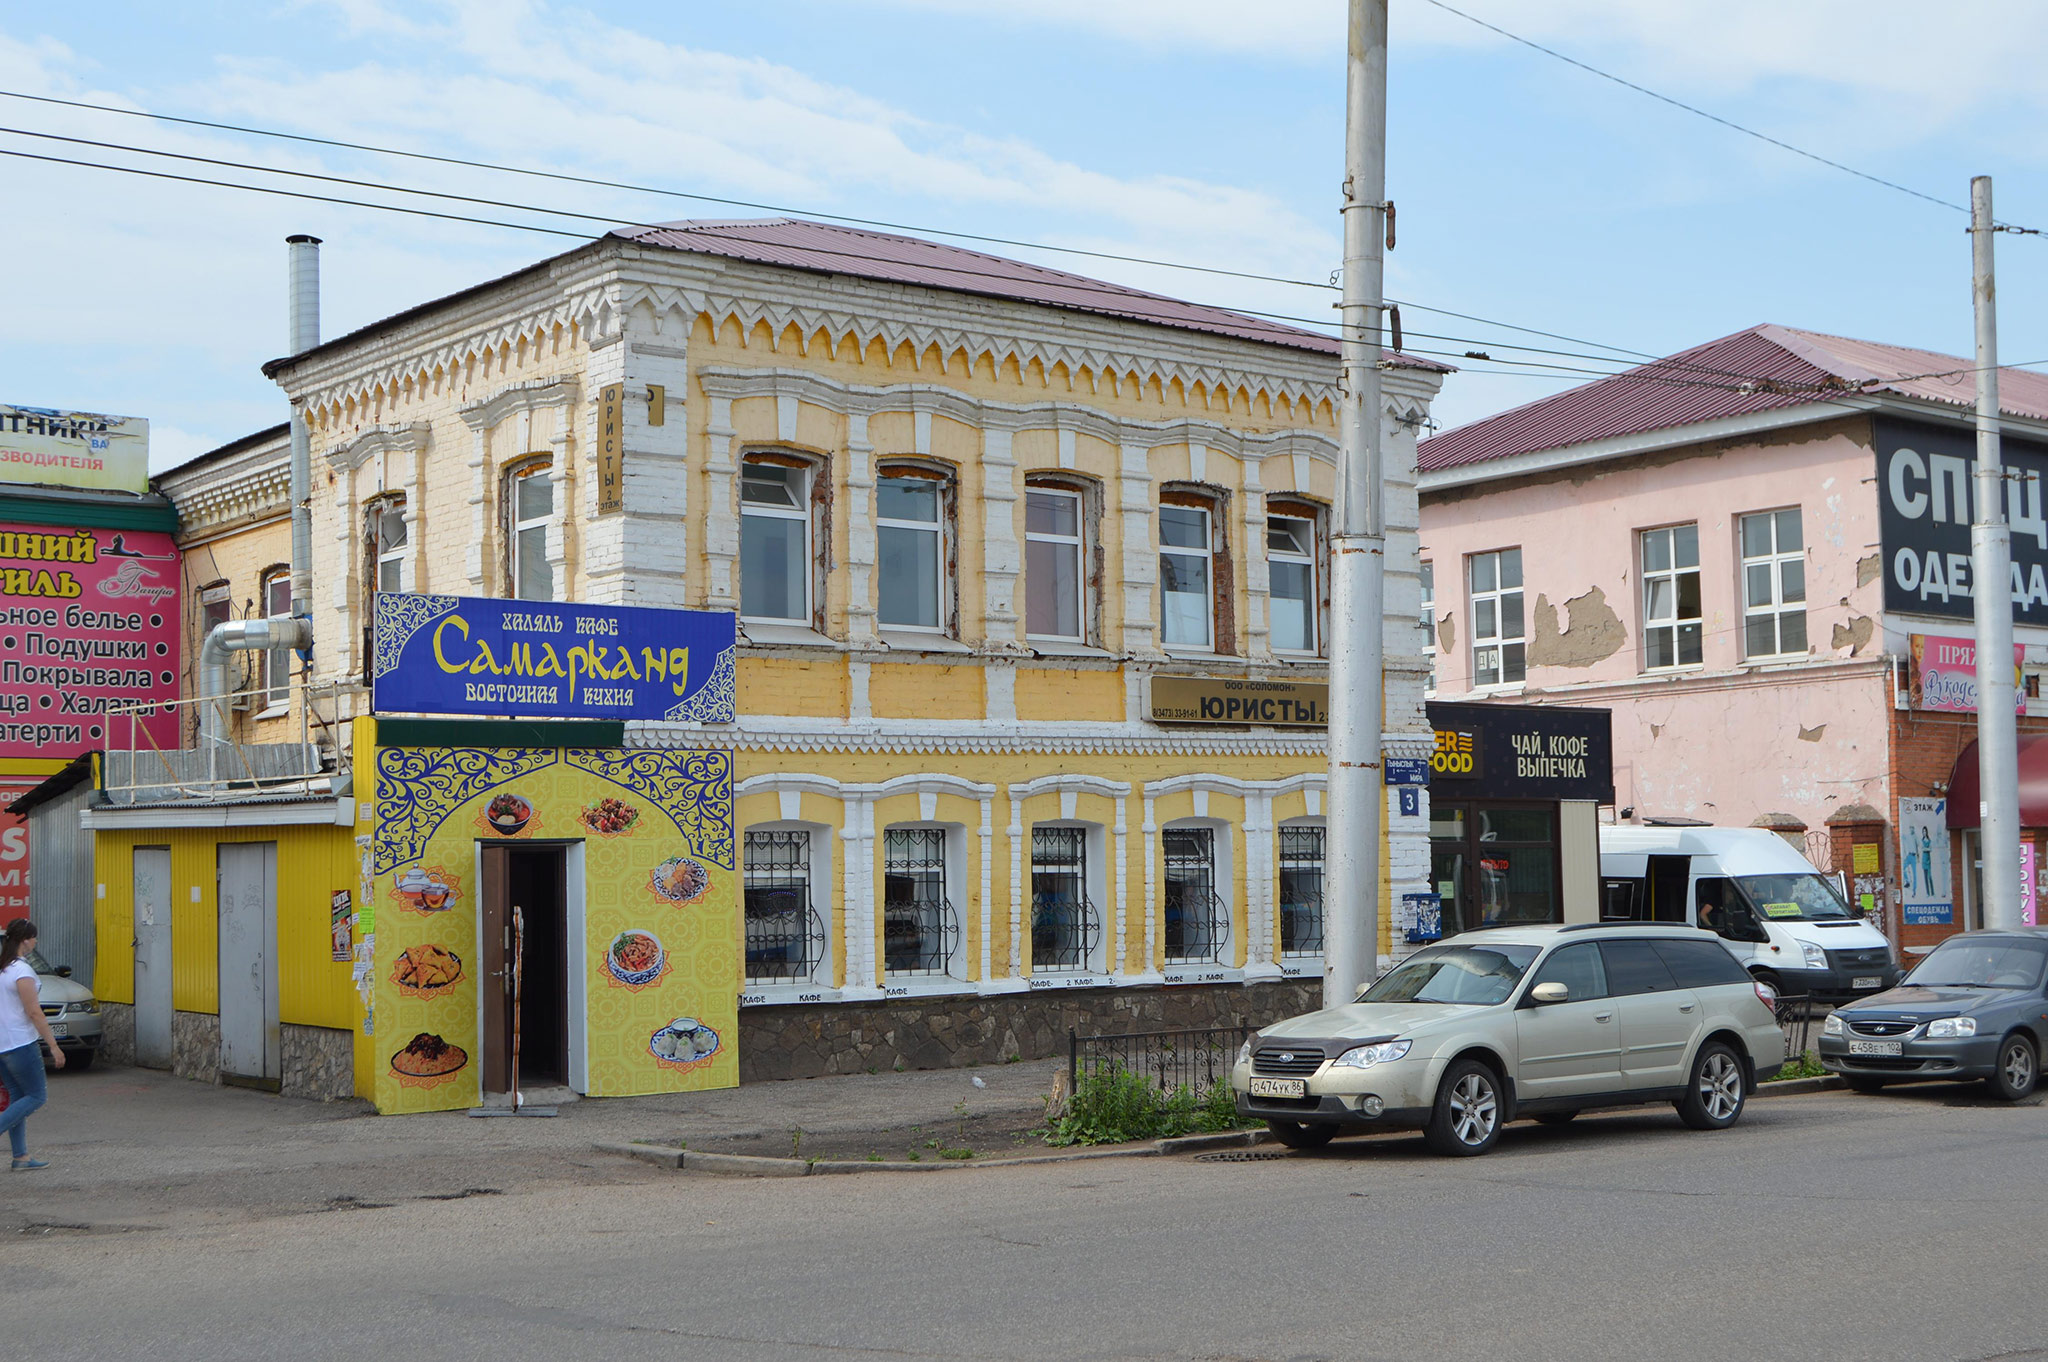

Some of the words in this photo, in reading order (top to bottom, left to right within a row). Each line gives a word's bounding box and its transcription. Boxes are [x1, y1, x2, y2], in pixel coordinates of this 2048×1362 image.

[604, 389, 616, 487] ЮРИСТЫ
[600, 499, 620, 511] этаж
[606, 490, 612, 500] 2
[1888, 448, 2047, 550] СПЦ
[1894, 547, 2048, 612] ОДЕДА
[65, 604, 142, 631] белье
[502, 612, 563, 633] ХАЛЯЛЬ
[575, 616, 619, 636] КАФЕ
[26, 632, 147, 662] Подушки
[432, 614, 690, 703] Самарканд
[2, 660, 153, 690] Покрывала
[465, 682, 558, 704] ВОСТОЧНАЯ
[583, 685, 634, 707] КУХНЯ
[1224, 681, 1243, 691] ООО
[60, 690, 156, 716] Халаты
[1200, 696, 1316, 722] ЮРИСТЫ
[1319, 711, 1325, 722] 2
[0, 722, 81, 747] терти
[1511, 731, 1545, 758] ЧАЙ,
[1550, 736, 1589, 756] КОФЕ
[1517, 757, 1587, 778] ВЫПЕЧКА
[1406, 794, 1415, 811] 3
[1914, 803, 1934, 812] ЭТАЖ
[1906, 905, 1950, 915] СПЕЦОДЕЖДА
[1074, 978, 1094, 986] КАФЕ
[1164, 975, 1184, 983] КАФЕ
[1206, 973, 1224, 981] КАФЕ
[1283, 968, 1301, 976] КАФЕ
[743, 995, 766, 1004] КАФЕ
[799, 993, 822, 1002] КАФЕ
[886, 987, 908, 996] КАФЕ
[1887, 1042, 1900, 1052] 102
[1253, 1080, 1290, 1094] О474УК
[1292, 1081, 1302, 1091] 86
